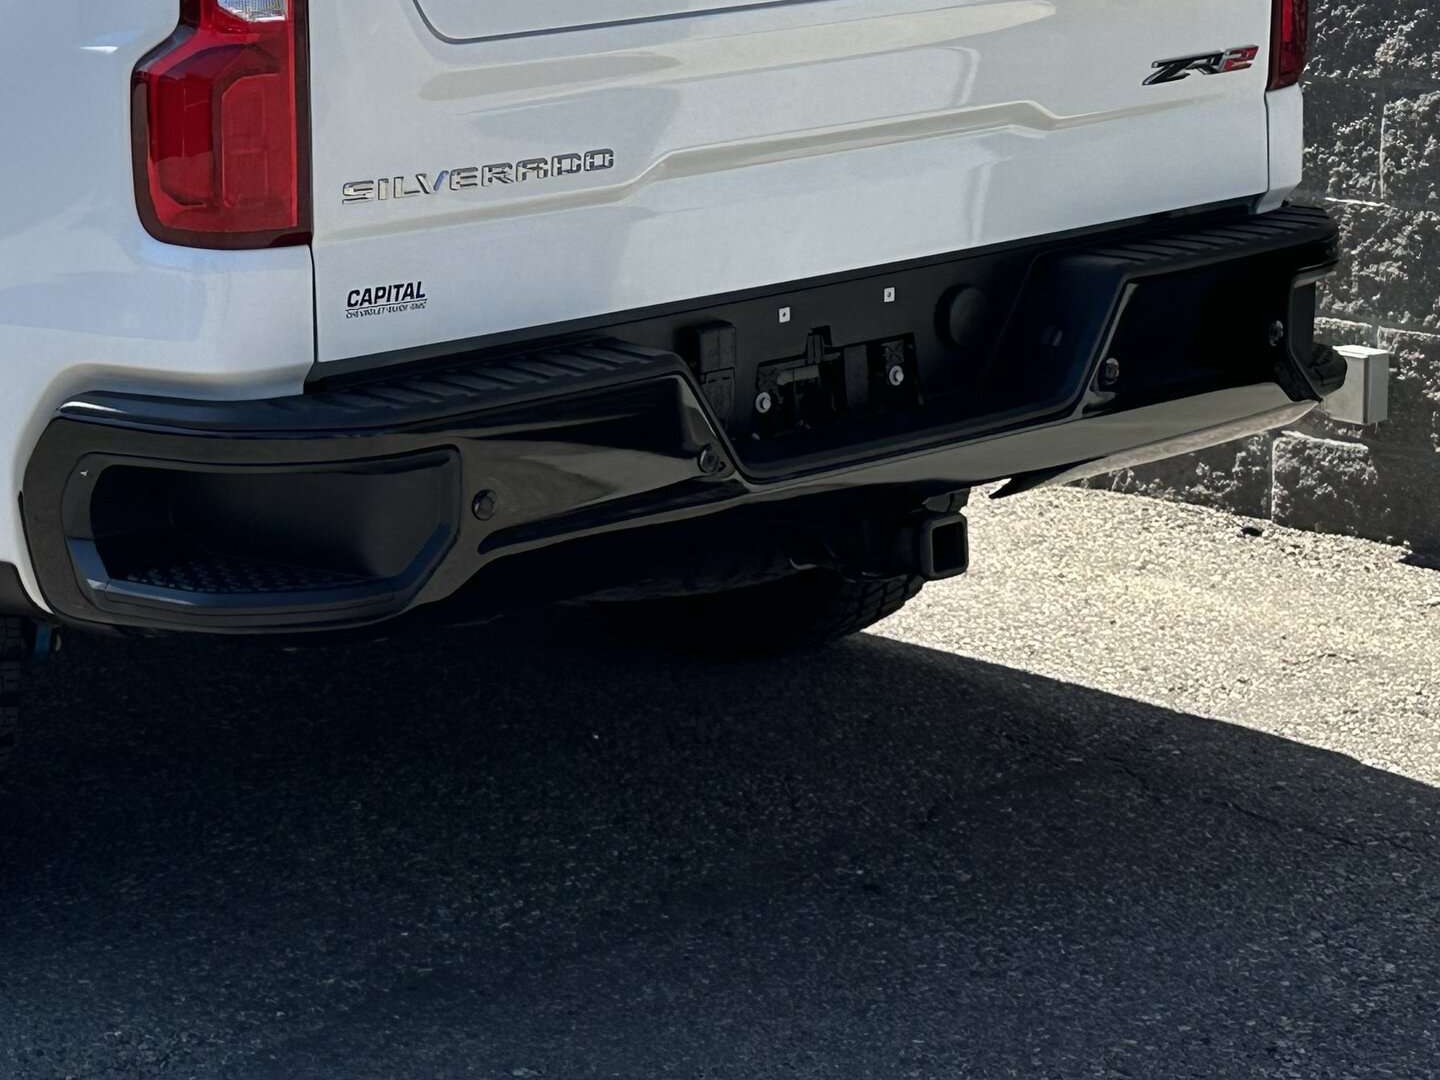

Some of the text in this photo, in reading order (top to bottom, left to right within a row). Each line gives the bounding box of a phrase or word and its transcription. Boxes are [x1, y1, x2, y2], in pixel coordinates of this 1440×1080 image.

[1142, 45, 1259, 86] ZR2
[341, 147, 615, 205] SILVERADO
[346, 281, 426, 308] CAPITAL
